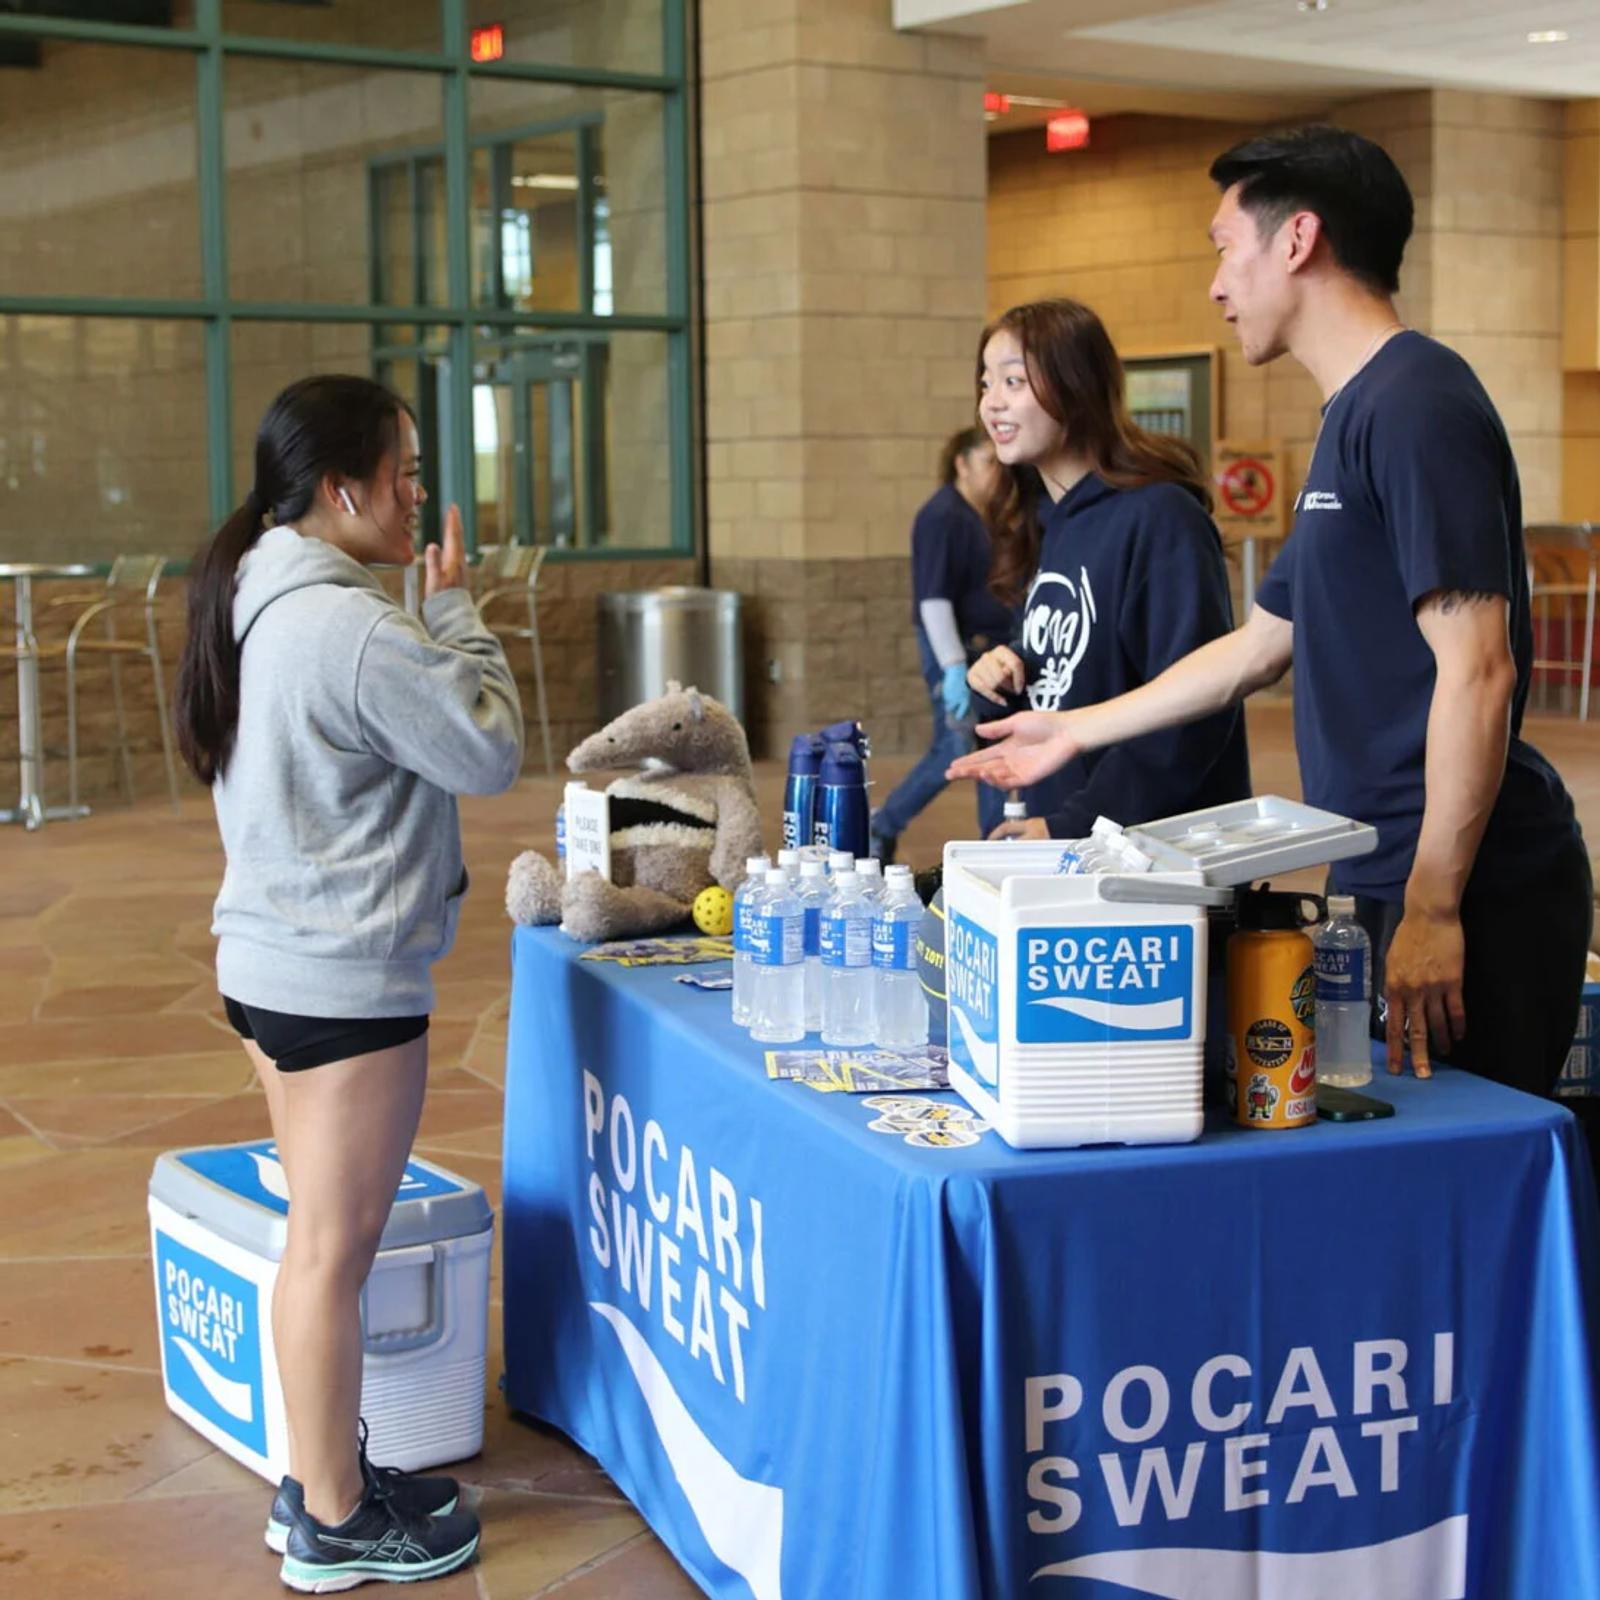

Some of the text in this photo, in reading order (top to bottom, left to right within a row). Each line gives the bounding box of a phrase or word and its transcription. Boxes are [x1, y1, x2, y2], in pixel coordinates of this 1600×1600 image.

[949, 919, 995, 985] POCARI
[1027, 963, 1166, 991] SWEAT
[1028, 936, 1178, 965] POCARI
[949, 957, 991, 1020] SWEAT
[583, 1068, 765, 1311] POCARI
[165, 1259, 243, 1335] POCARI
[588, 1171, 750, 1405] SWEAT
[167, 1293, 237, 1363] SWEAT
[1024, 1332, 1454, 1453] POCARI
[1026, 1416, 1419, 1535] SWEAT
